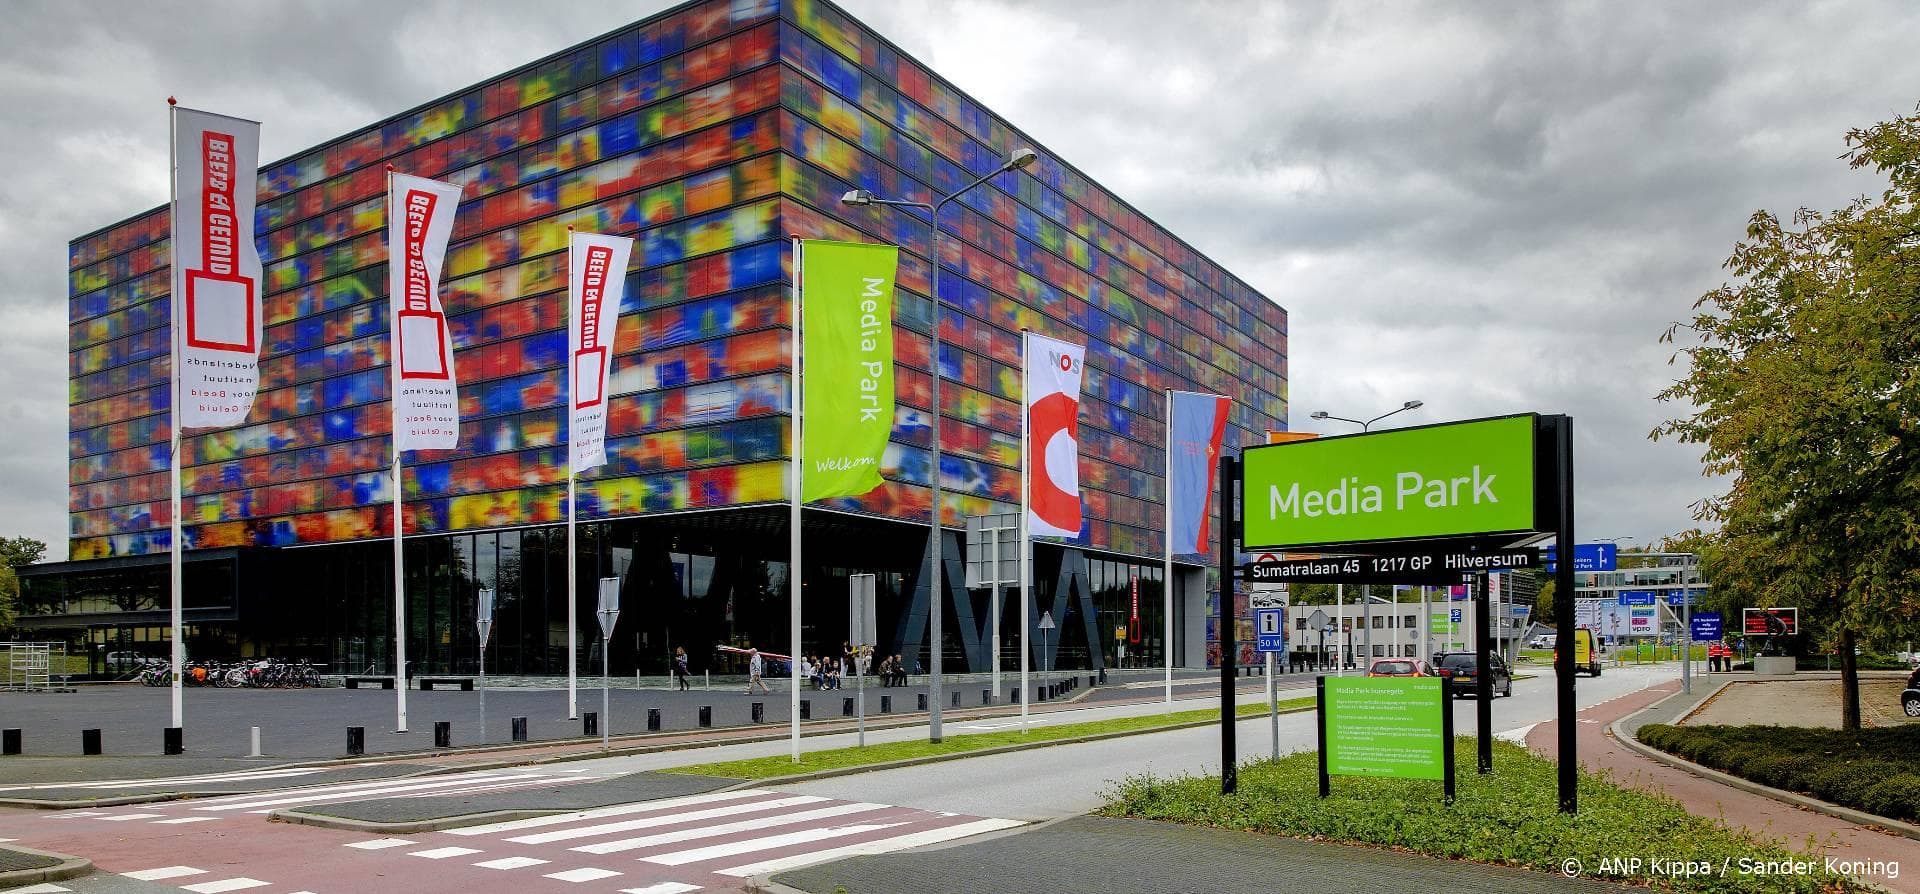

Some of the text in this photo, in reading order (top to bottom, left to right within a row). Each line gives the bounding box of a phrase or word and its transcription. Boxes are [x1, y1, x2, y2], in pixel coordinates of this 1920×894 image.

[860, 277, 884, 423] Media Park
[1049, 350, 1080, 375] NOS
[815, 454, 877, 473] Welkom
[1269, 464, 1499, 521] Media Park
[1253, 551, 1529, 578] Sumatralaan 45 1217 GP Hilversum
[1260, 639, 1280, 647] 50 M
